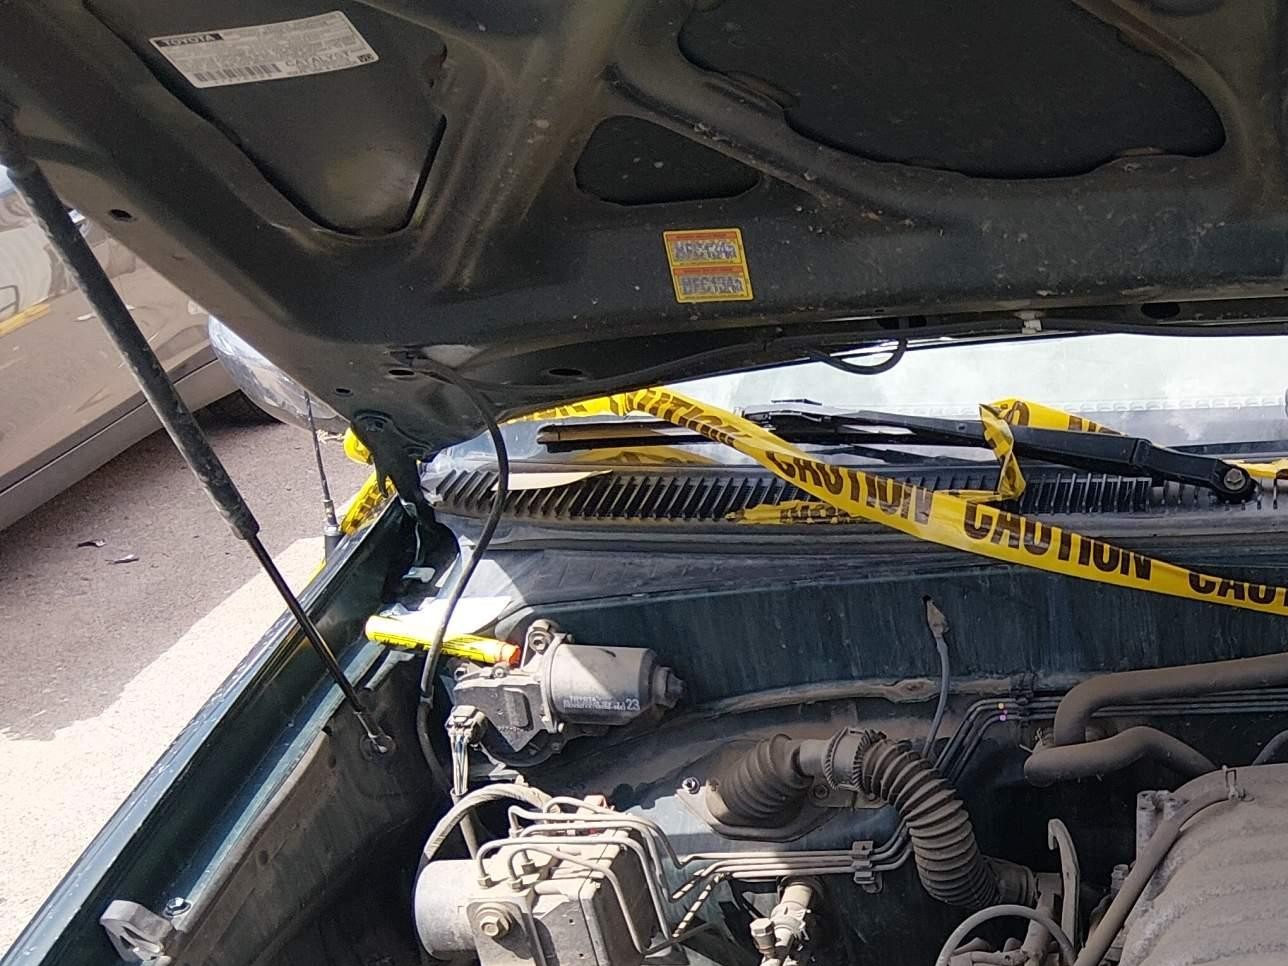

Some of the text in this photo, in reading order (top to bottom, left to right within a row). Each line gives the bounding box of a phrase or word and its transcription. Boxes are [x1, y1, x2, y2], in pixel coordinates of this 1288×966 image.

[163, 33, 216, 47] TOYOTA
[766, 450, 933, 524] CAUTION
[962, 502, 1151, 581] CAUTION
